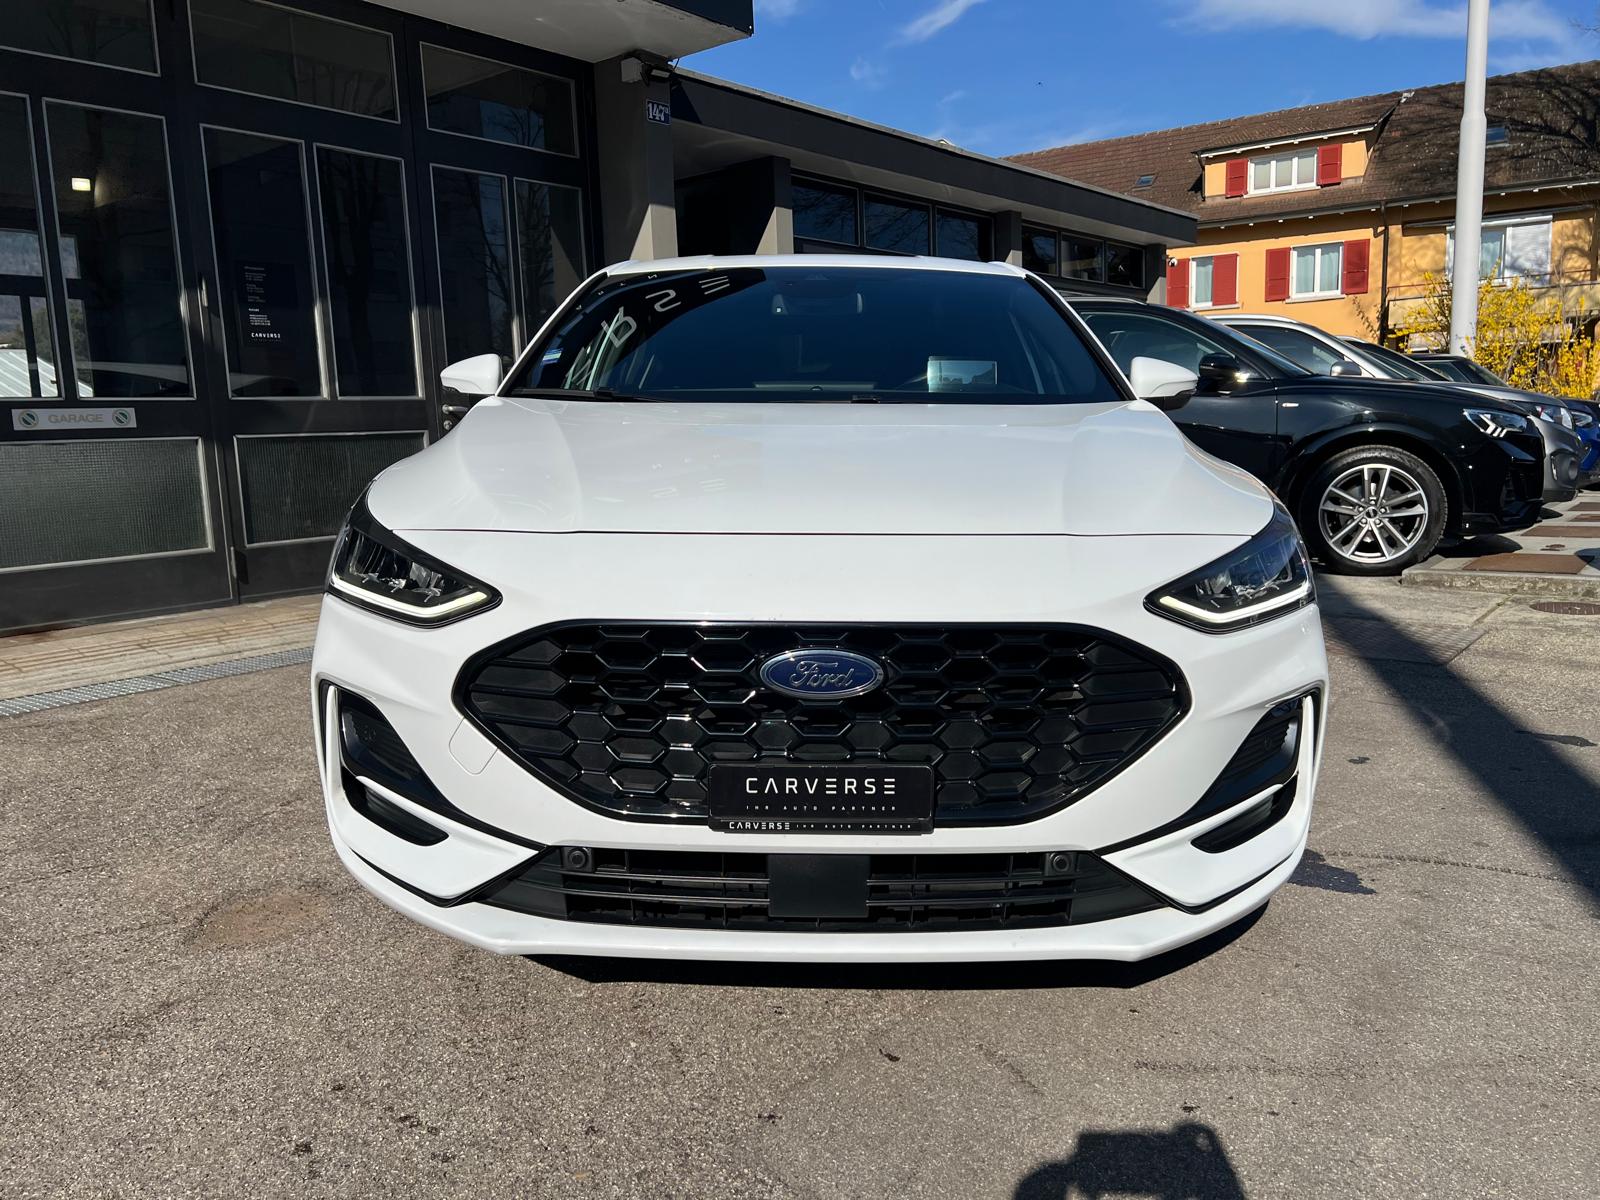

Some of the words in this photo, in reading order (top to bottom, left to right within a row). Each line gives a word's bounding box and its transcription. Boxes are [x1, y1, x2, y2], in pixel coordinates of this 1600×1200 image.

[48, 413, 105, 424] GARAGE
[789, 660, 855, 687] Ford
[745, 777, 896, 795] CARVERSE
[729, 821, 790, 830] CARVERSE
